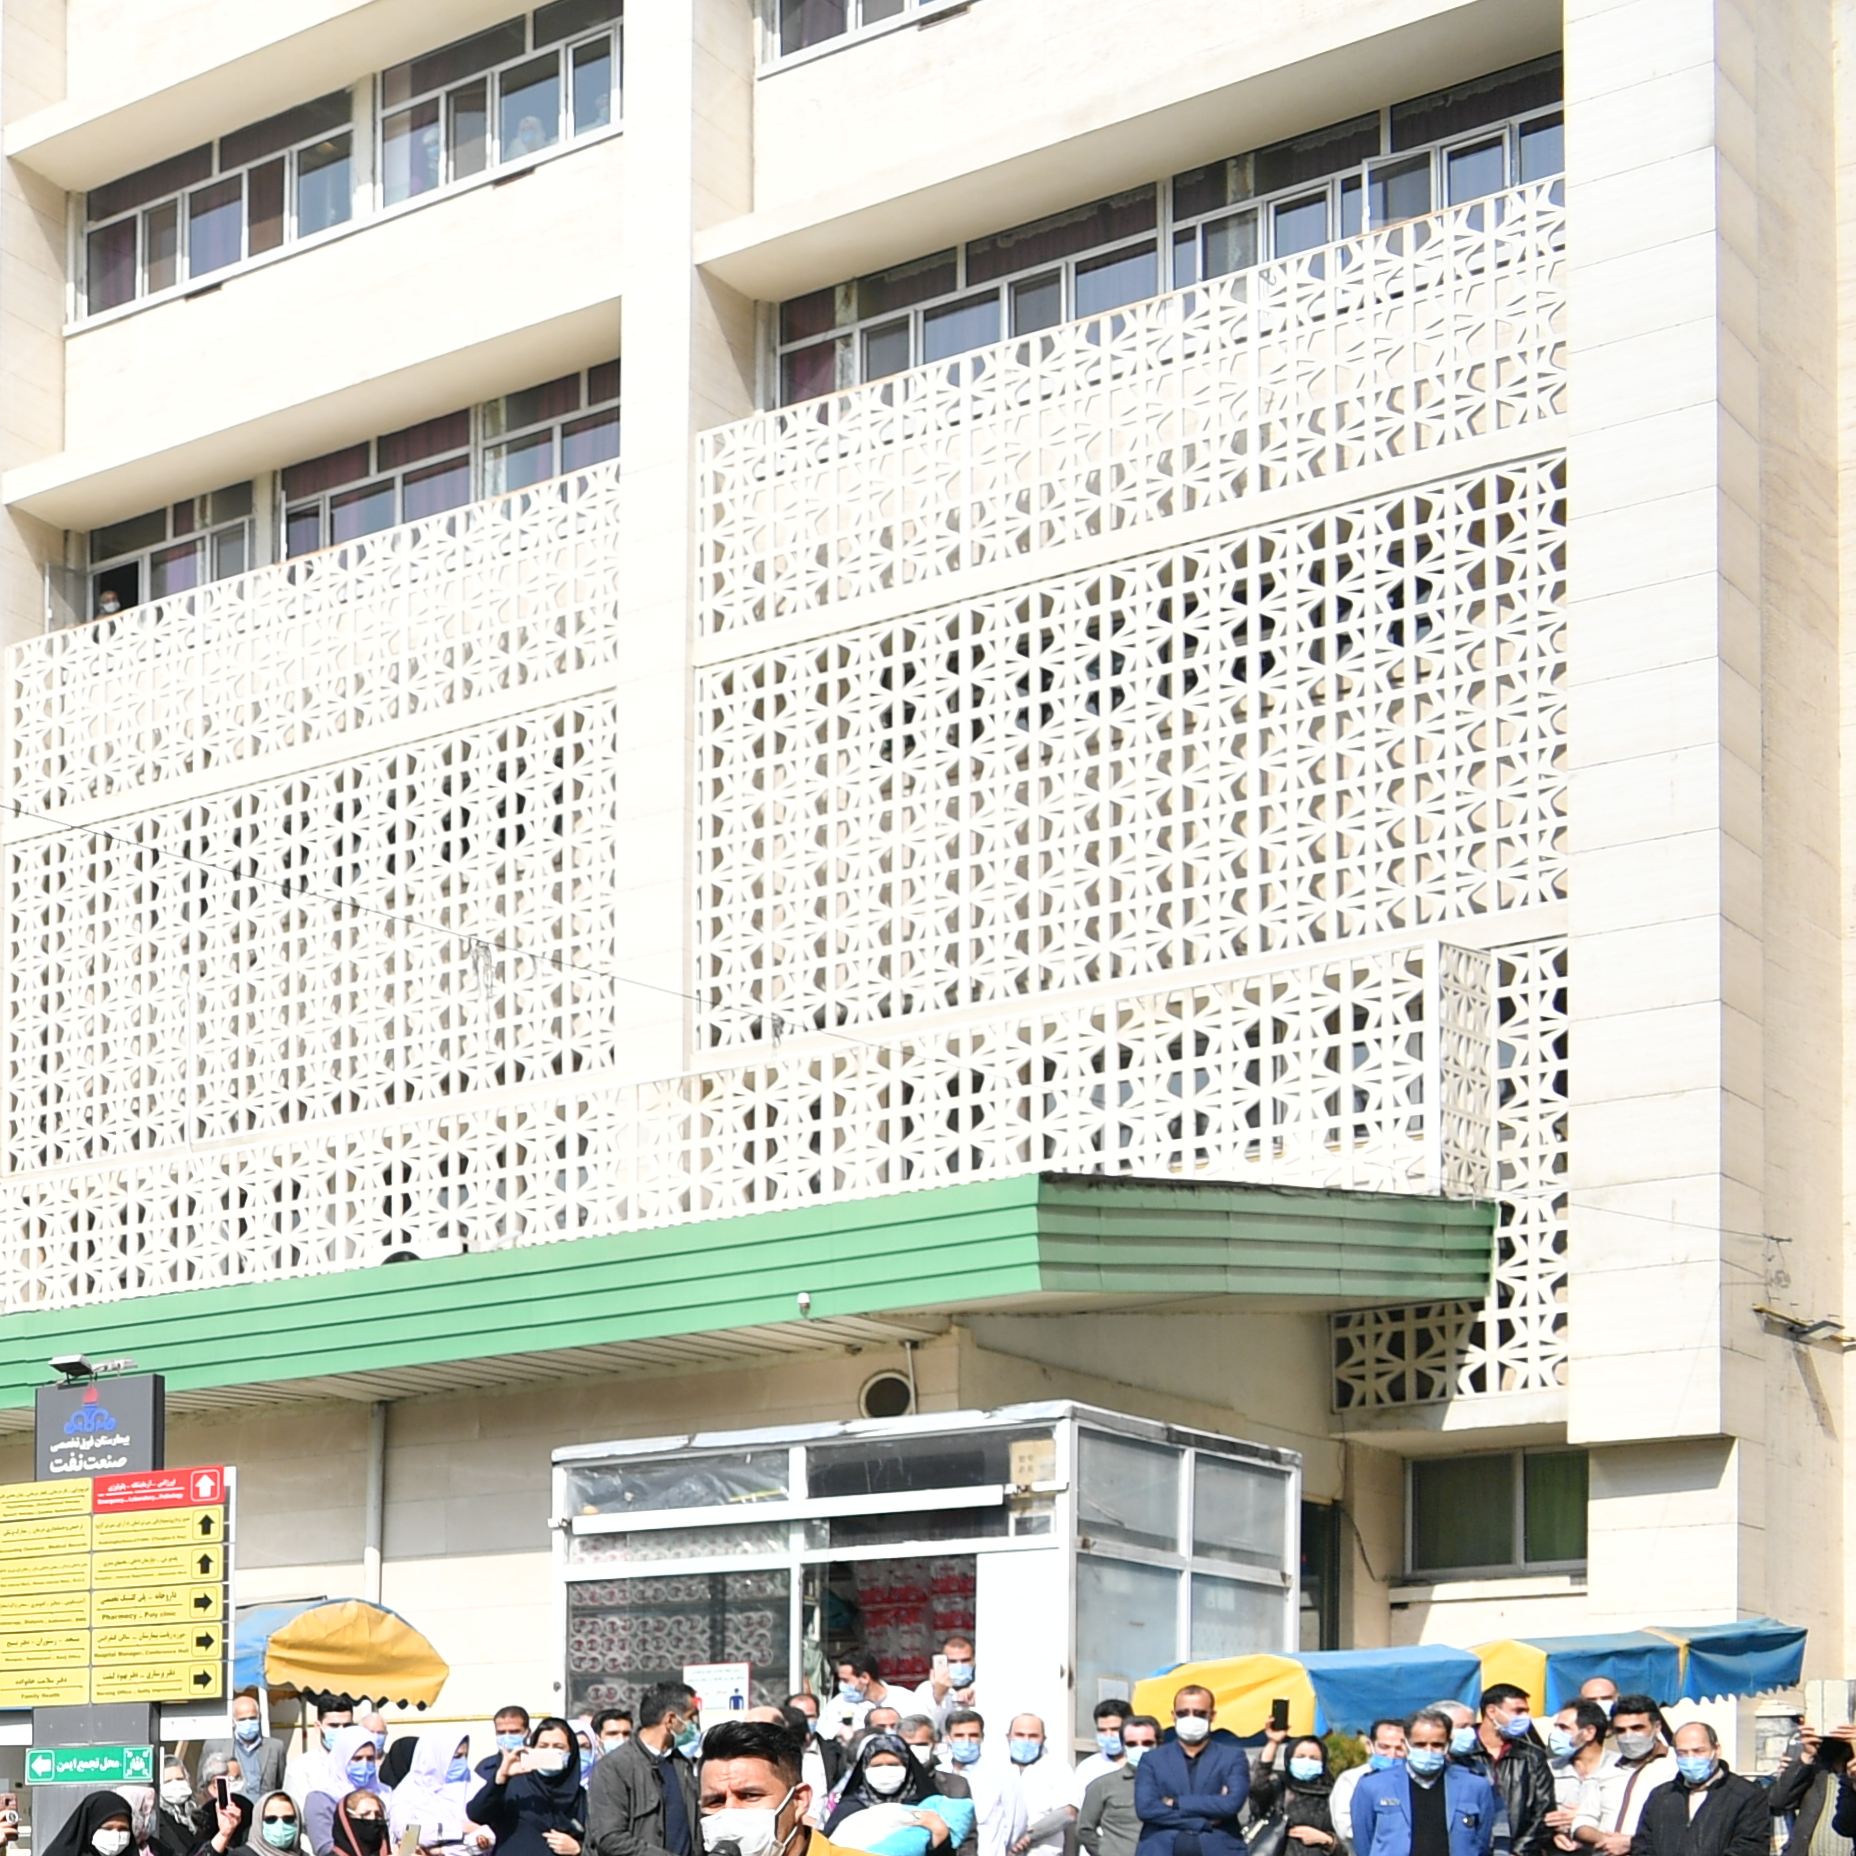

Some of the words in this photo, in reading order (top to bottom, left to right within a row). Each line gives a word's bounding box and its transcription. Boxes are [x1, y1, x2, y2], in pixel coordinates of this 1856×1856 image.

[49, 1452, 83, 1473] نفت
[83, 1454, 128, 1470] صنعت
[56, 1758, 77, 1773] ایمن
[77, 1757, 100, 1772] تجمع
[100, 1756, 120, 1771] محل
